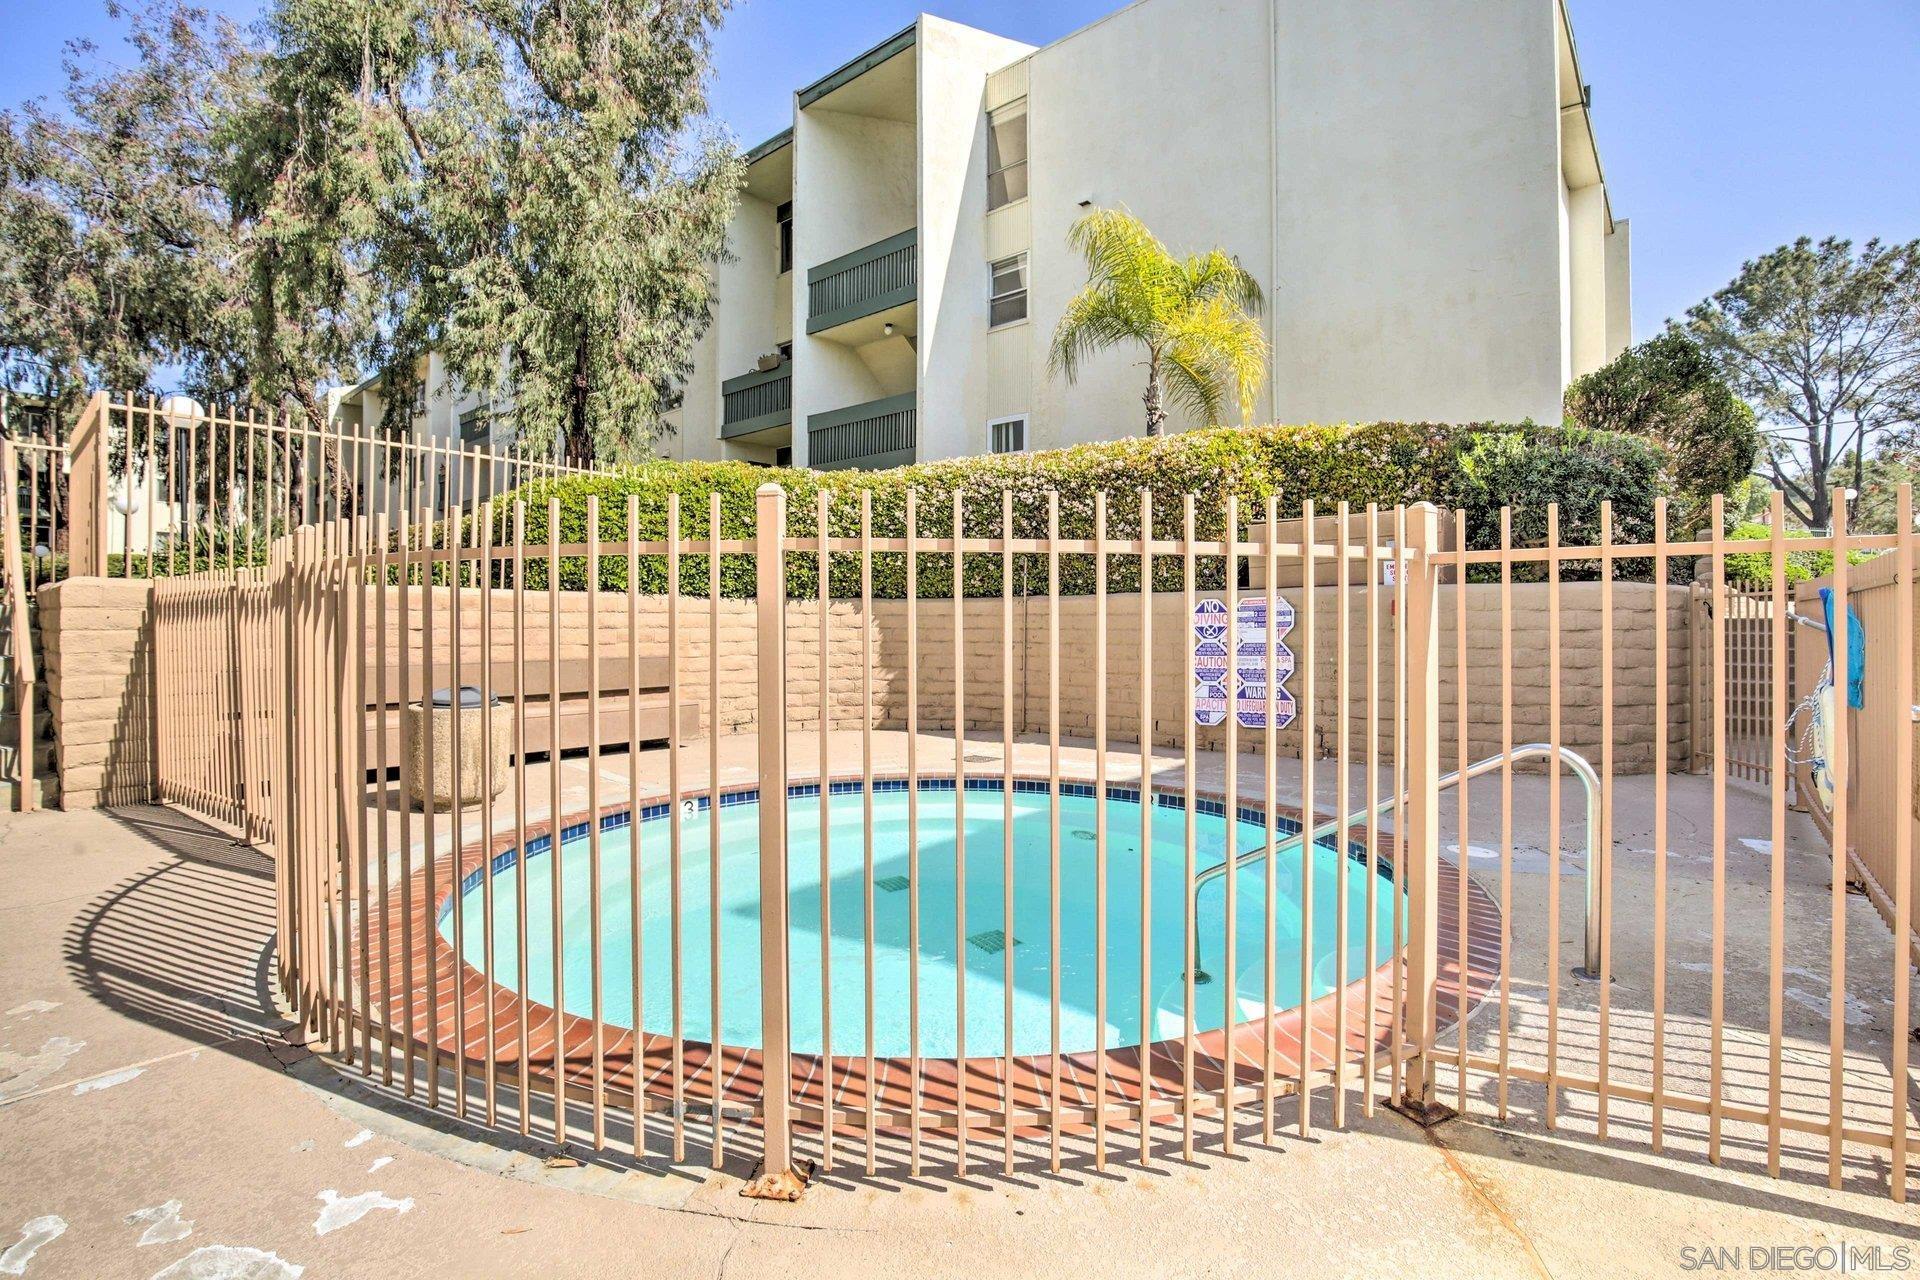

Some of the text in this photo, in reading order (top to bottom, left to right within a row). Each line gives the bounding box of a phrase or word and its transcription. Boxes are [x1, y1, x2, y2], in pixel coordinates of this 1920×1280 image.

[1204, 601, 1219, 613] NO
[1195, 657, 1228, 667] AUTION
[1242, 700, 1266, 712] LIFEGUAR
